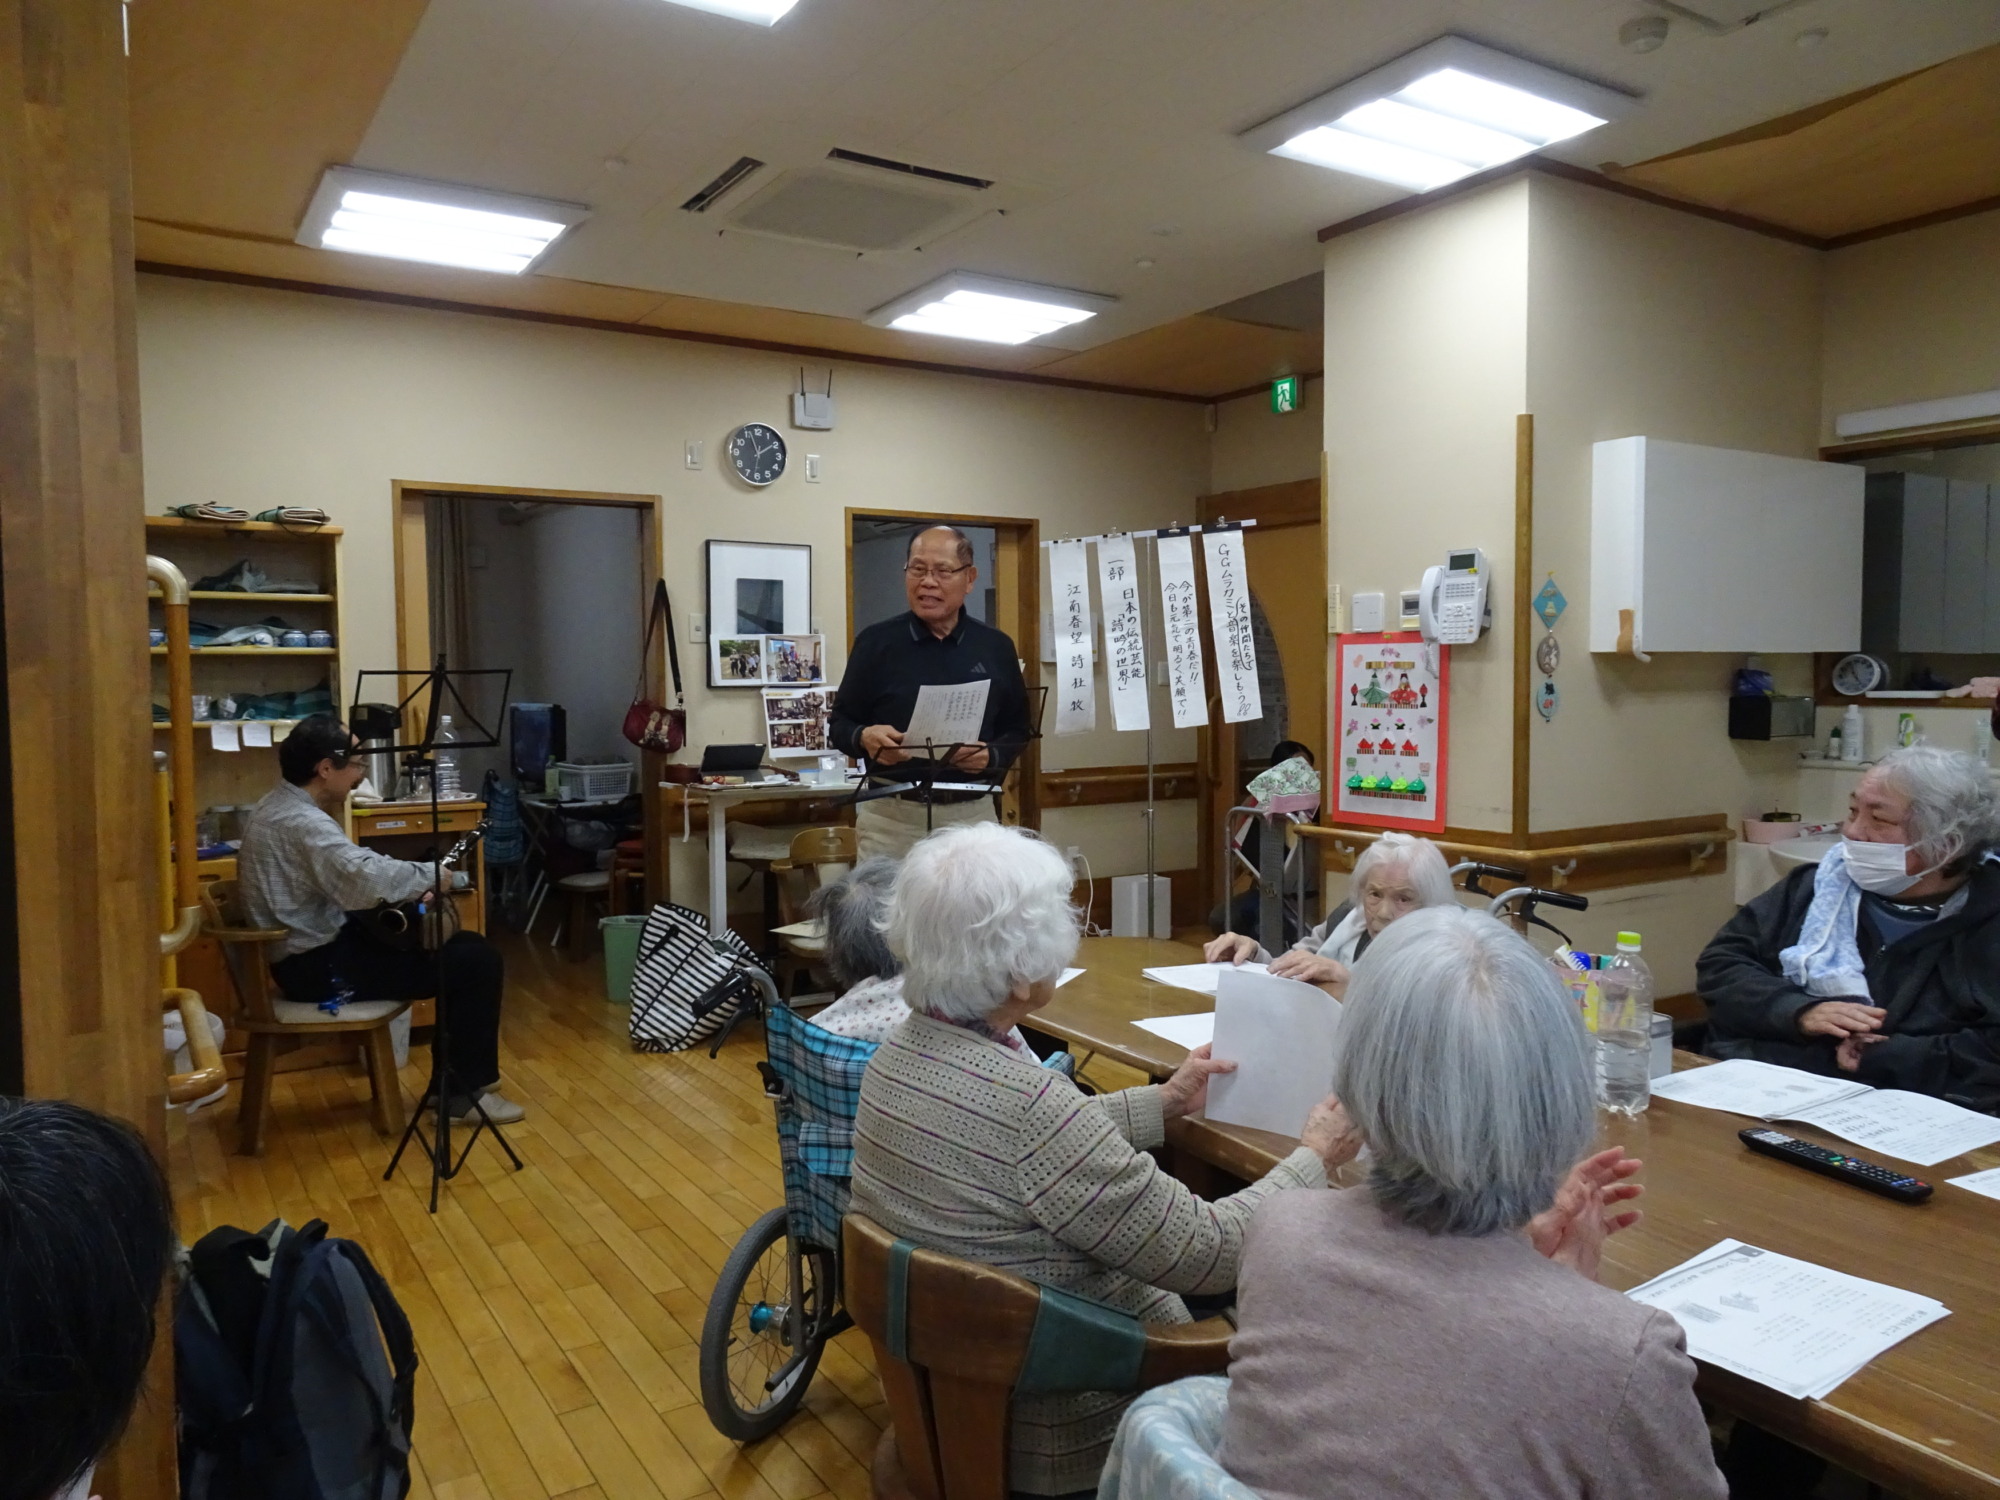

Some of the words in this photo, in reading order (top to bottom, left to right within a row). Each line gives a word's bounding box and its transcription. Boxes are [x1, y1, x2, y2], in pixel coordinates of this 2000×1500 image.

[733, 448, 739, 456] 9
[773, 441, 779, 449] 2
[1108, 560, 1124, 580] 一部
[1123, 588, 1145, 679] 日本の伝統芸能
[1111, 613, 1129, 691] 「詩吟の世界」
